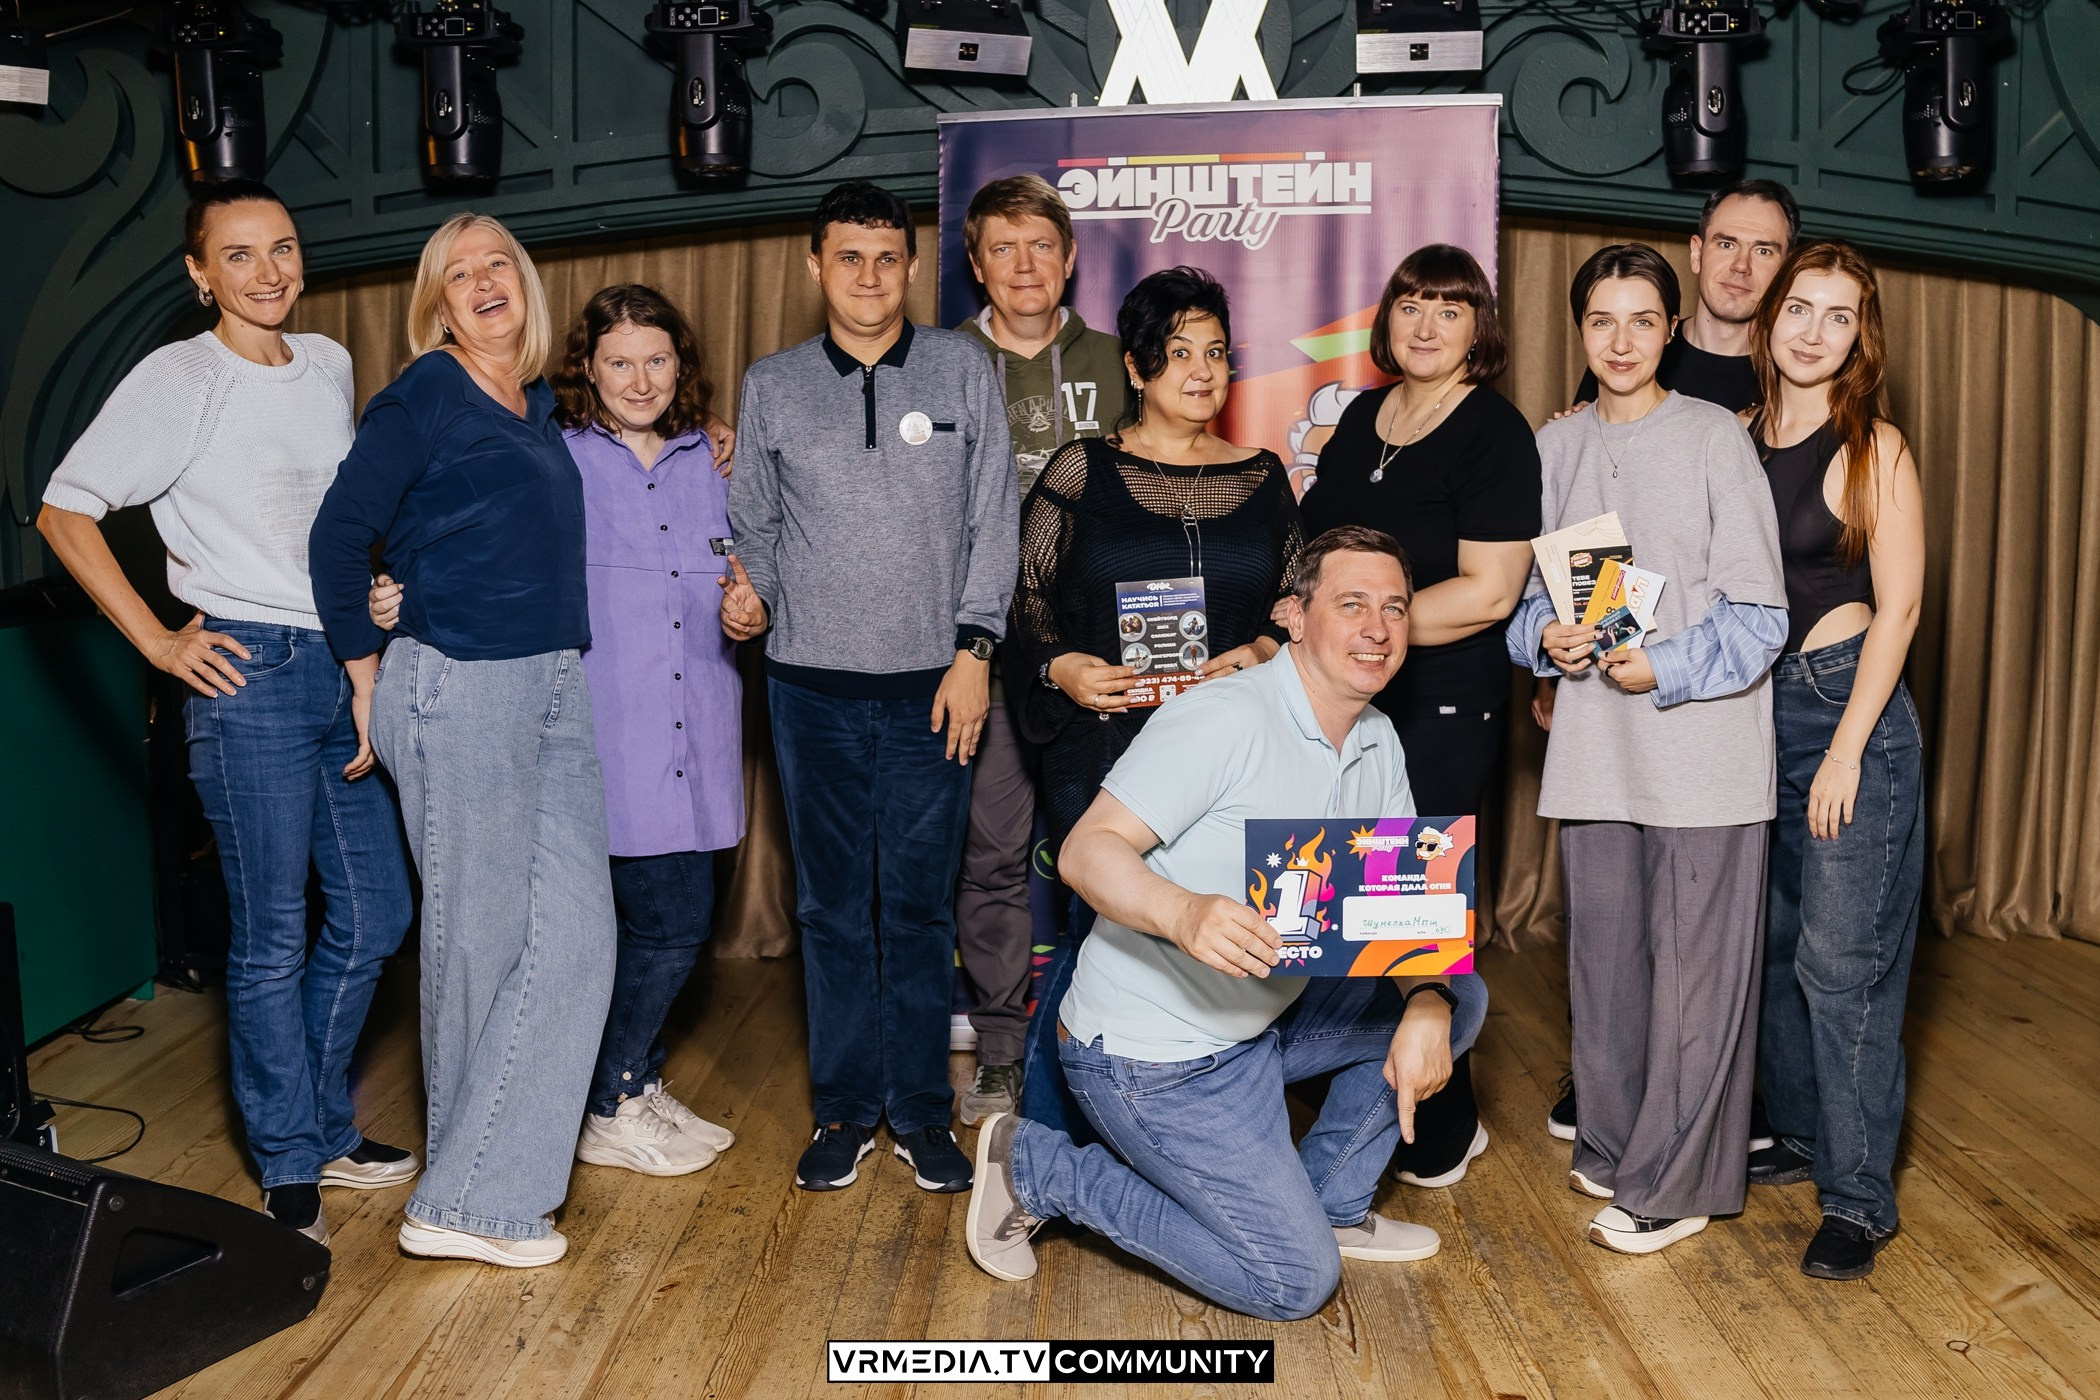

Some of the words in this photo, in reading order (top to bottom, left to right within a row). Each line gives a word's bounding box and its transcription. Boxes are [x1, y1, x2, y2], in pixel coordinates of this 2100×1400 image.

[1057, 154, 1372, 209] ЭЙНШТЕЙН
[1150, 198, 1281, 251] Party
[1061, 381, 1097, 422] 17
[1121, 595, 1159, 604] НАУЧИСЬ
[1122, 602, 1160, 610] КАТАТЬСЯ
[1358, 884, 1401, 892] КОТОРАЯ
[1401, 883, 1428, 892] ДАЛА
[1429, 882, 1452, 891] ОГНЯ
[1266, 870, 1314, 938] 1
[1274, 945, 1323, 959] ЕСТО
